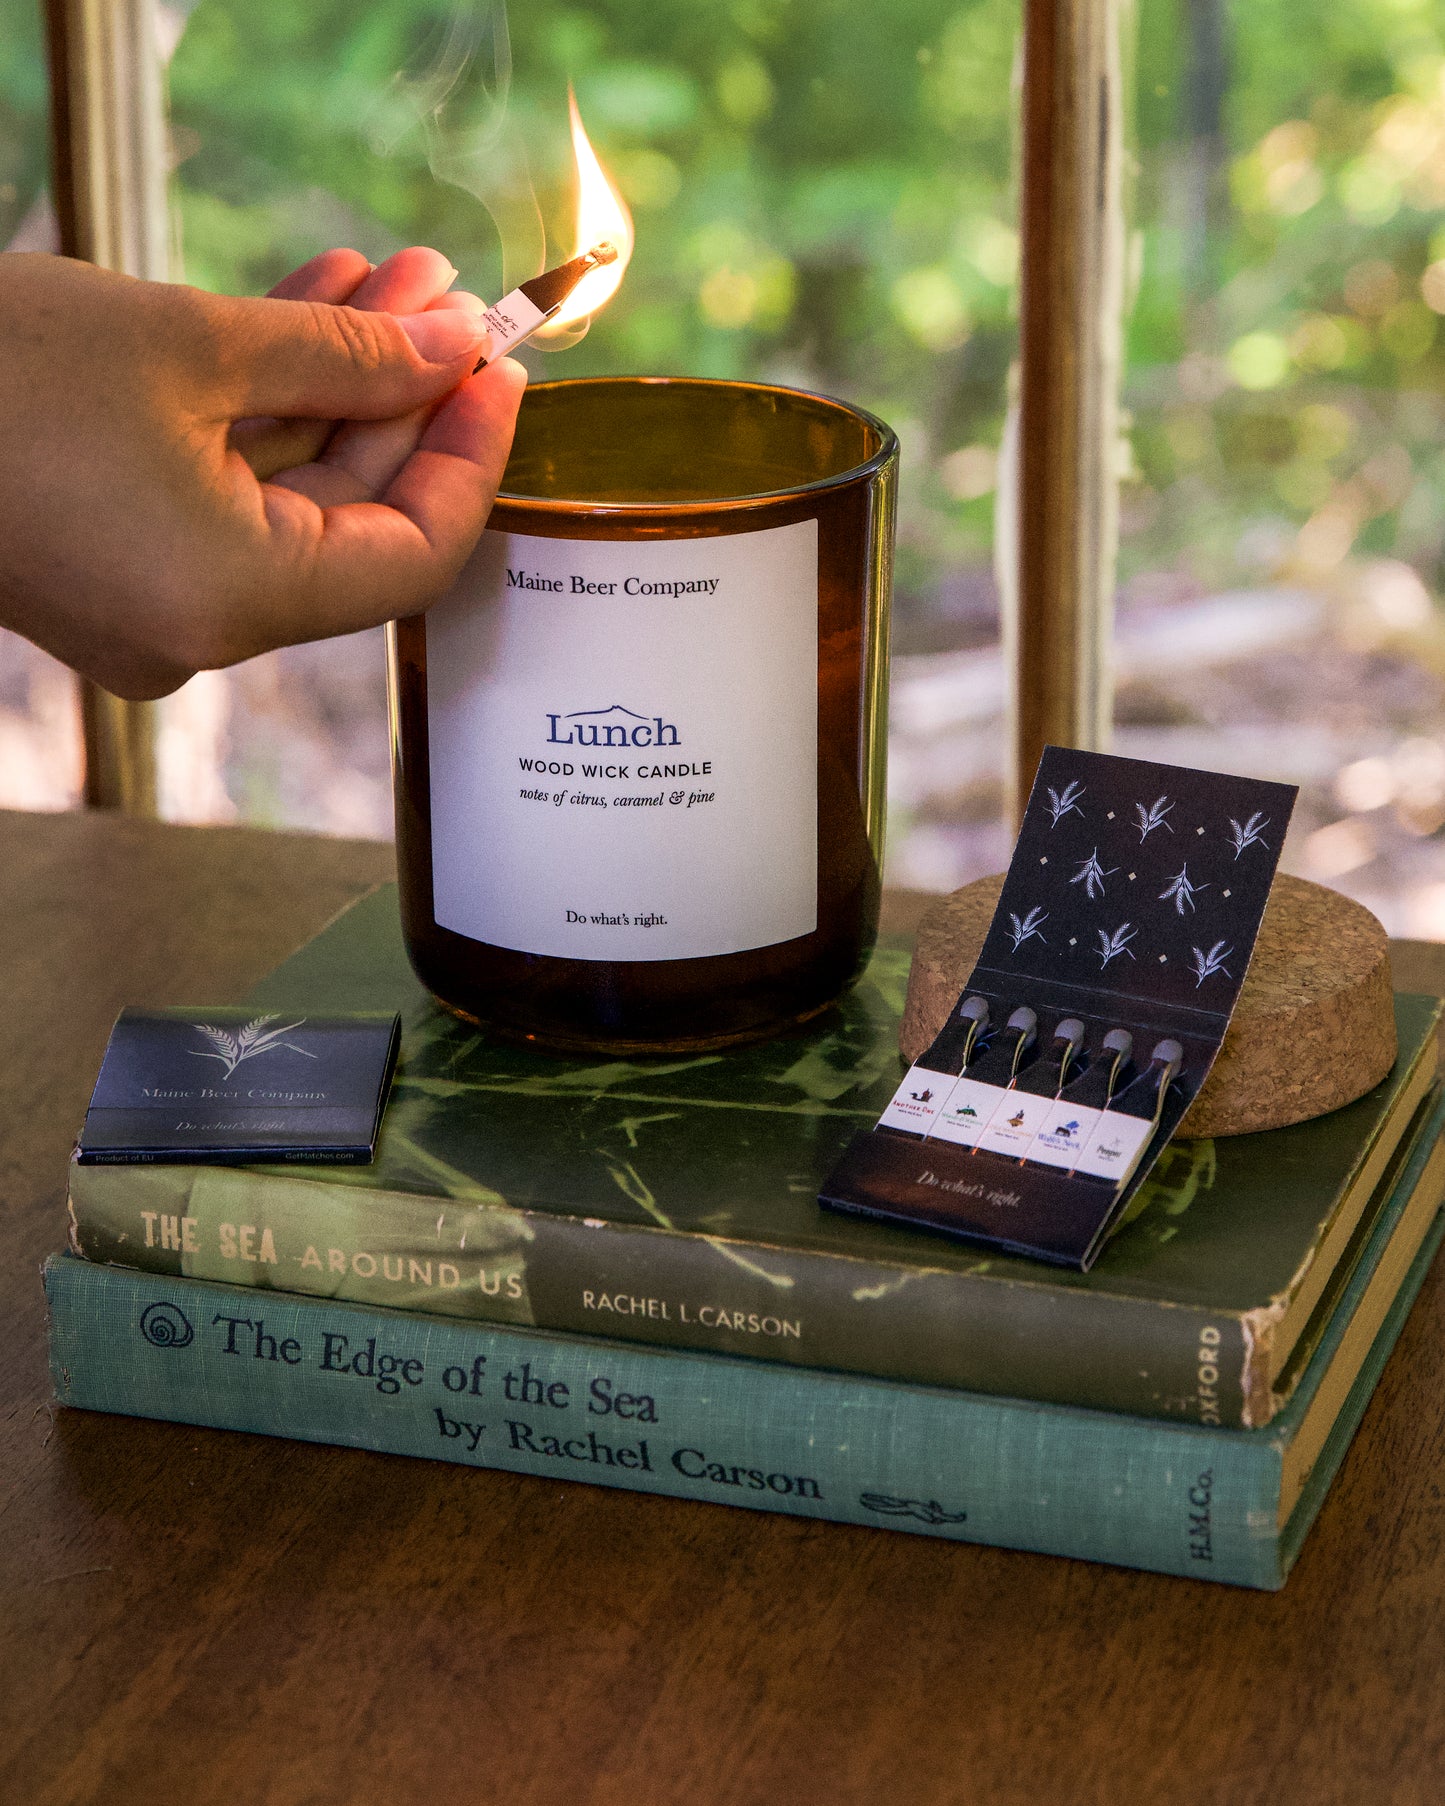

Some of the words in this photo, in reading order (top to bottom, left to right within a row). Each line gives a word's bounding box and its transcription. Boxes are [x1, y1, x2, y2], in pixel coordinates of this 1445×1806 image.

[506, 569, 563, 593] Maine
[570, 576, 617, 595] Beer
[624, 576, 719, 598] Company
[546, 712, 681, 748] Lunch
[519, 758, 574, 776] WOOD
[582, 764, 630, 779] WICK
[638, 761, 712, 778] CANDLE
[519, 788, 549, 802] notes
[553, 789, 567, 806] of
[570, 792, 608, 808] citrus,
[613, 792, 664, 807] caramel
[669, 791, 685, 805] &
[687, 790, 715, 808] pine
[566, 911, 587, 924] Do
[590, 912, 629, 926] what's
[634, 913, 668, 928] right.
[141, 1087, 194, 1098] Maine
[200, 1088, 238, 1098] Beer
[247, 1089, 326, 1101] Company
[175, 1121, 197, 1131] Do
[95, 1154, 129, 1162] Product
[285, 1152, 355, 1160] GetMatches.com
[916, 1170, 939, 1186] Do
[141, 1210, 202, 1254] THE
[219, 1222, 278, 1265] SEA
[300, 1246, 461, 1291] AROUND
[479, 1269, 524, 1300] US
[583, 1290, 672, 1320] RACHEL
[212, 1313, 301, 1364] The
[319, 1332, 424, 1394] Edge
[442, 1355, 486, 1395] of
[503, 1365, 570, 1410] the
[588, 1377, 659, 1424] Sea
[435, 1407, 487, 1452] by
[508, 1419, 652, 1473] Rachel
[671, 1447, 823, 1500] Carson
